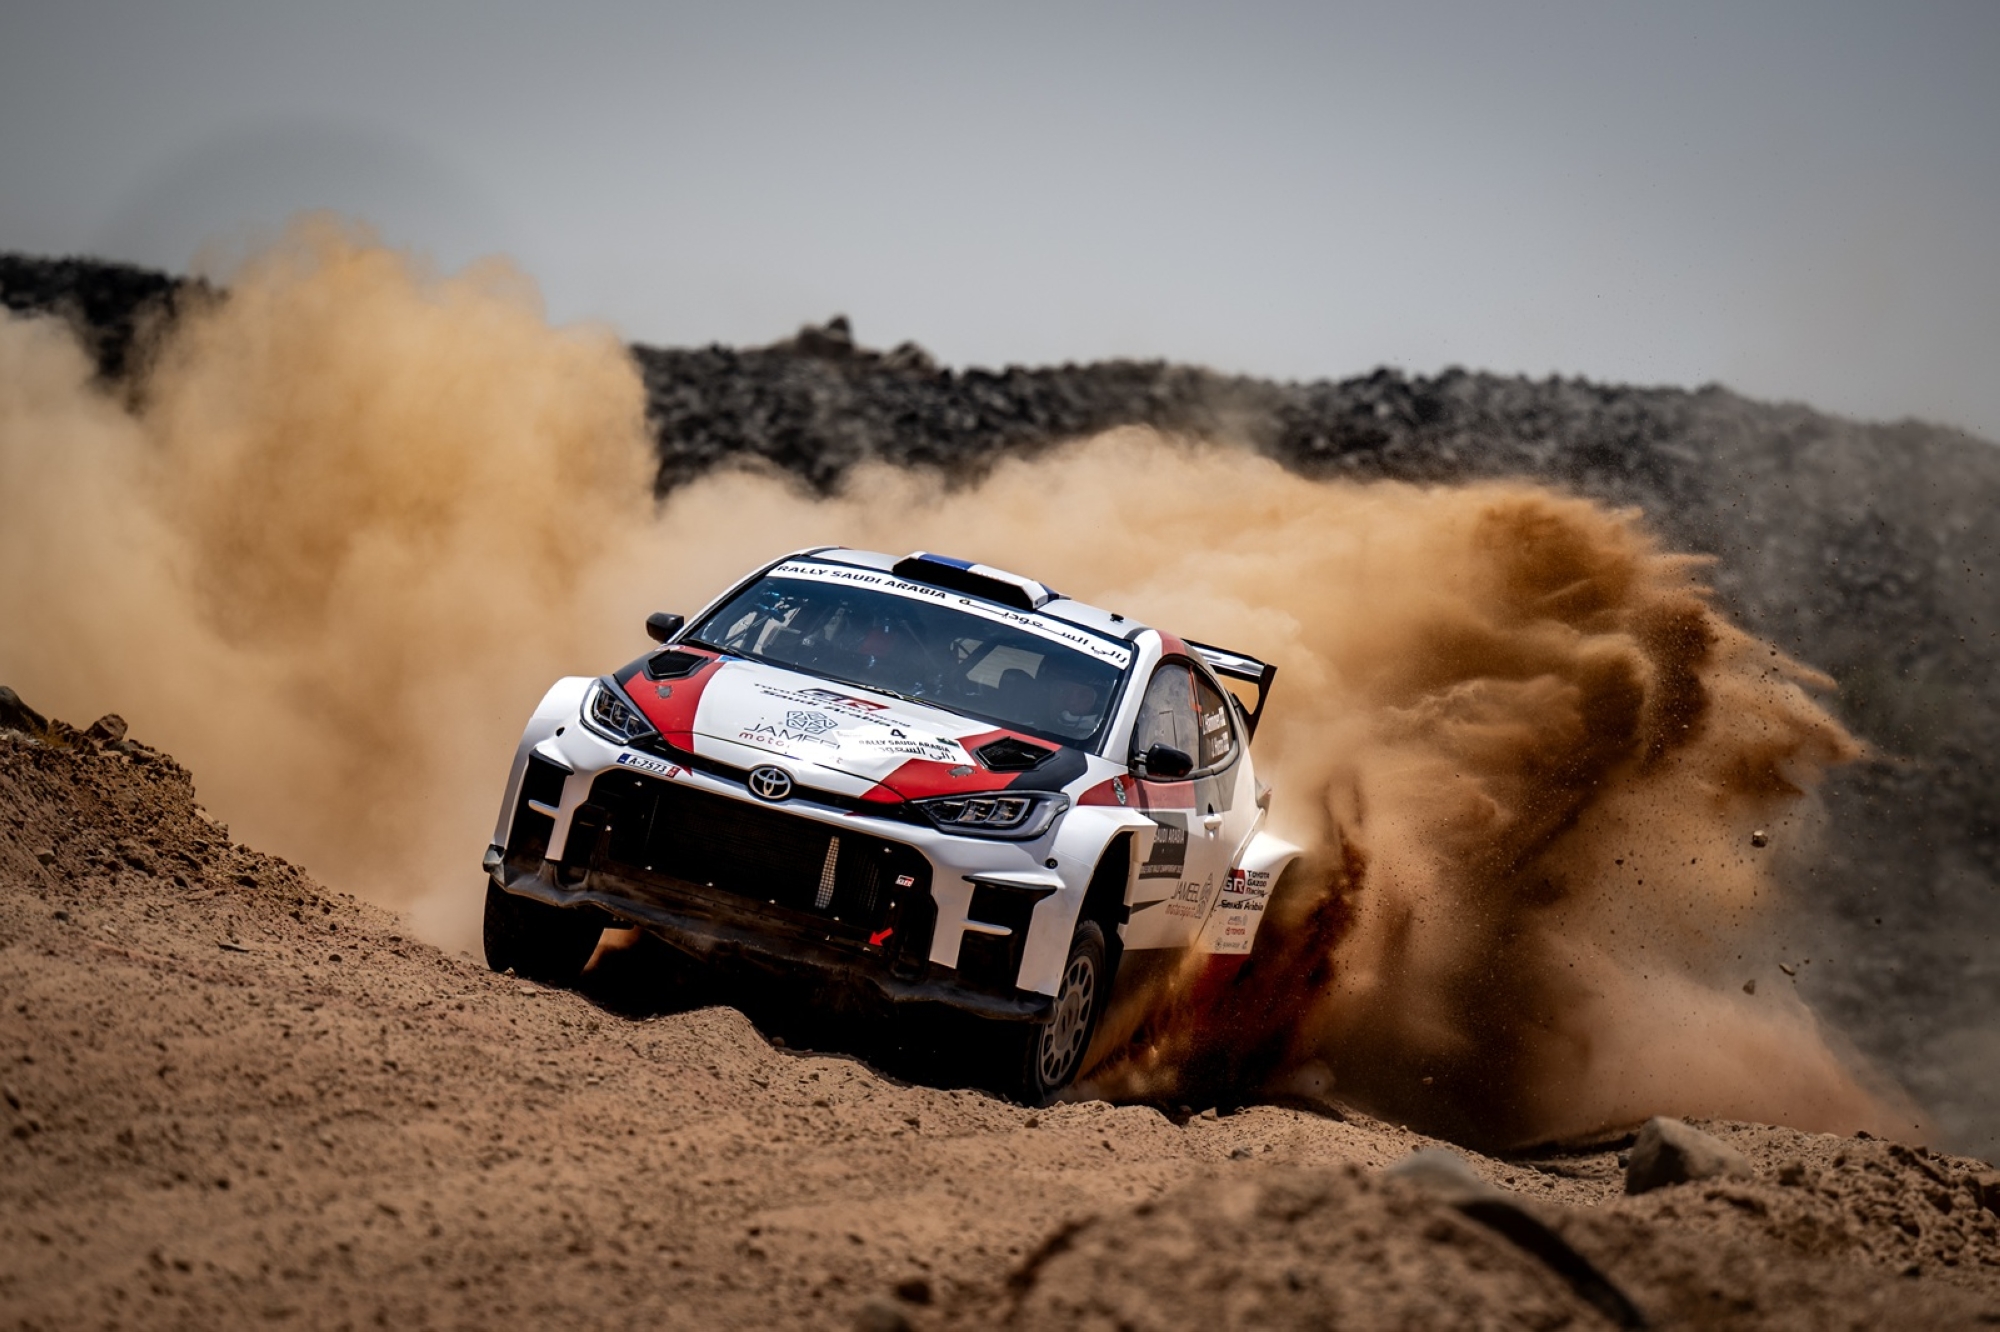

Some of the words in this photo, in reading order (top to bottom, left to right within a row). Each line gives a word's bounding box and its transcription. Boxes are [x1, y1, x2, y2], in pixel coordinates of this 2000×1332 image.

[777, 565, 827, 576] RALLY
[830, 570, 881, 584] SAUDI
[884, 579, 947, 599] ARABIA
[890, 729, 907, 739] 4
[919, 742, 951, 753] ARABIA
[1247, 870, 1270, 879] TOYOTA
[1223, 877, 1245, 894] GR
